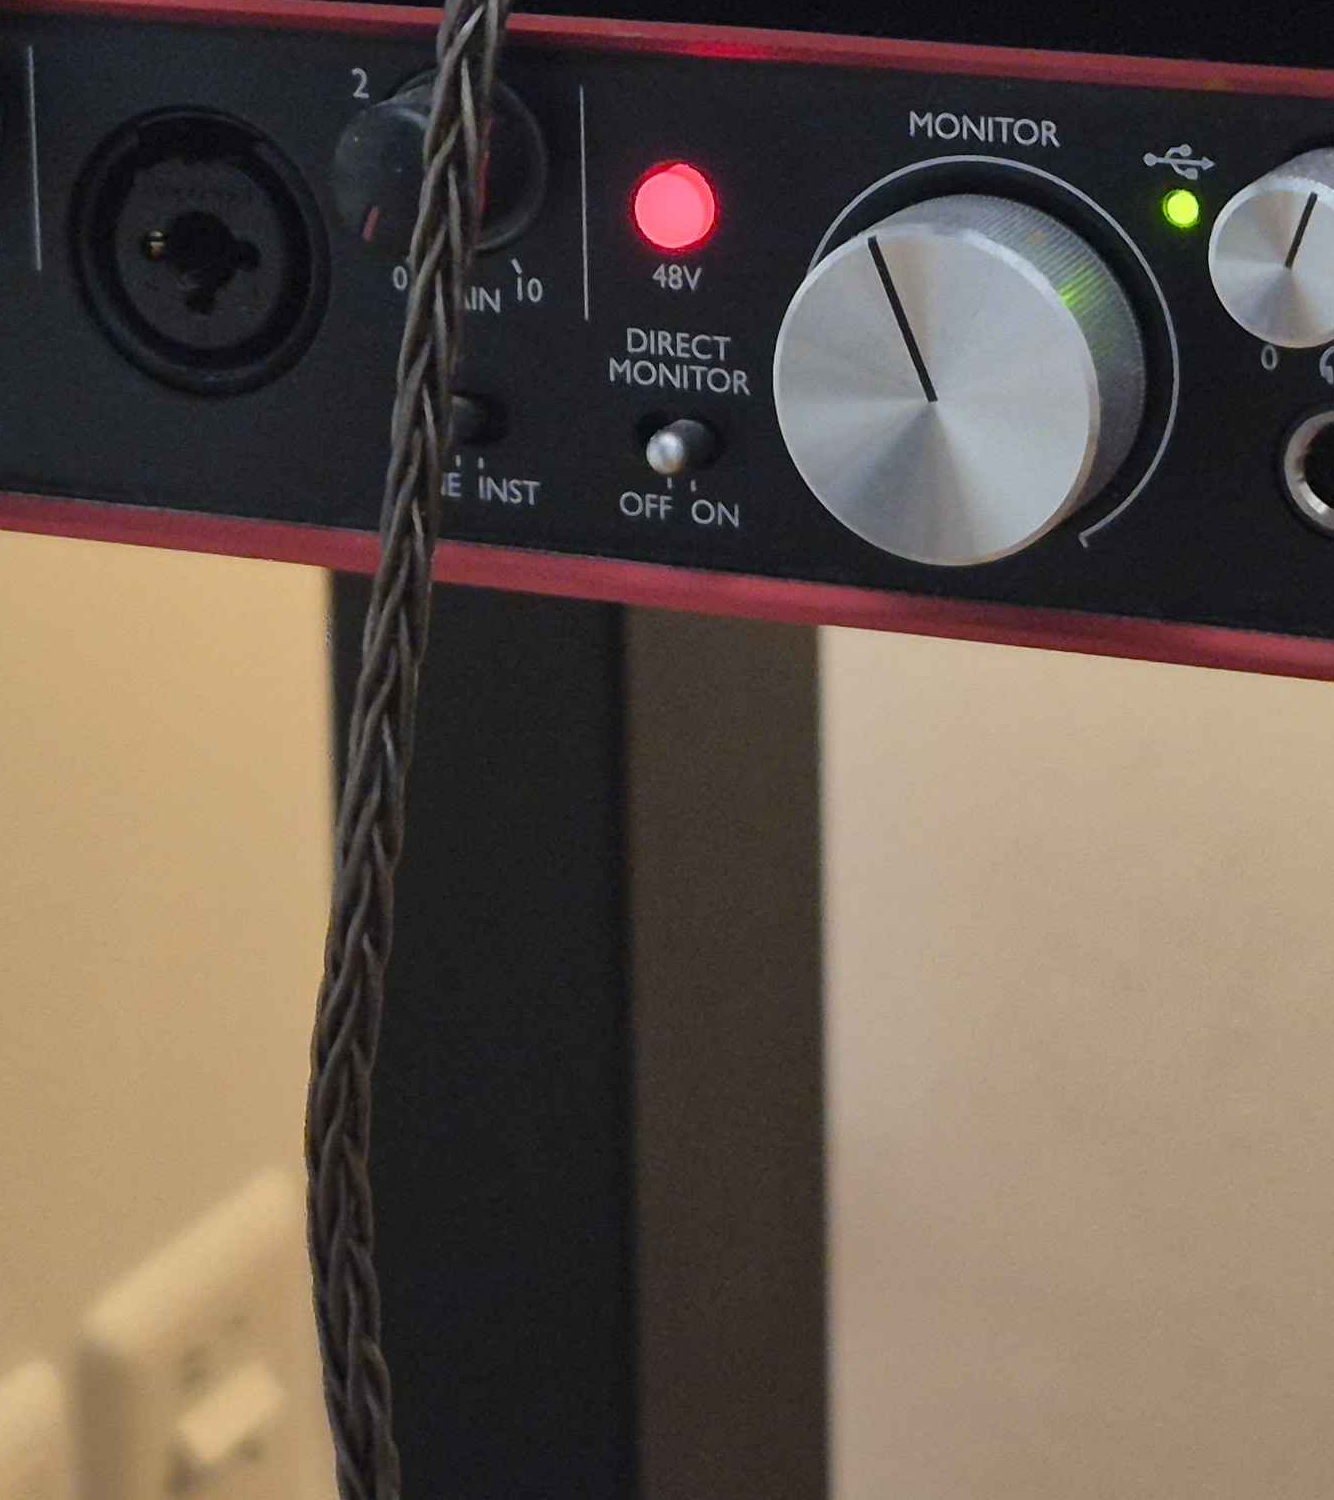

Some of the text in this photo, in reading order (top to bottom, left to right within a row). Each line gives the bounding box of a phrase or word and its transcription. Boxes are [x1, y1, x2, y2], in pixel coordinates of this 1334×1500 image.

[351, 68, 369, 99] 2
[908, 110, 1060, 148] MONITOR
[392, 265, 409, 291] 0
[517, 276, 544, 303] 10
[651, 264, 703, 291] 48V
[626, 328, 732, 361] DIRECT
[1260, 346, 1279, 371] 0
[609, 358, 750, 396] MONITOR
[478, 475, 541, 506] INST
[619, 492, 741, 529] OFF ON
